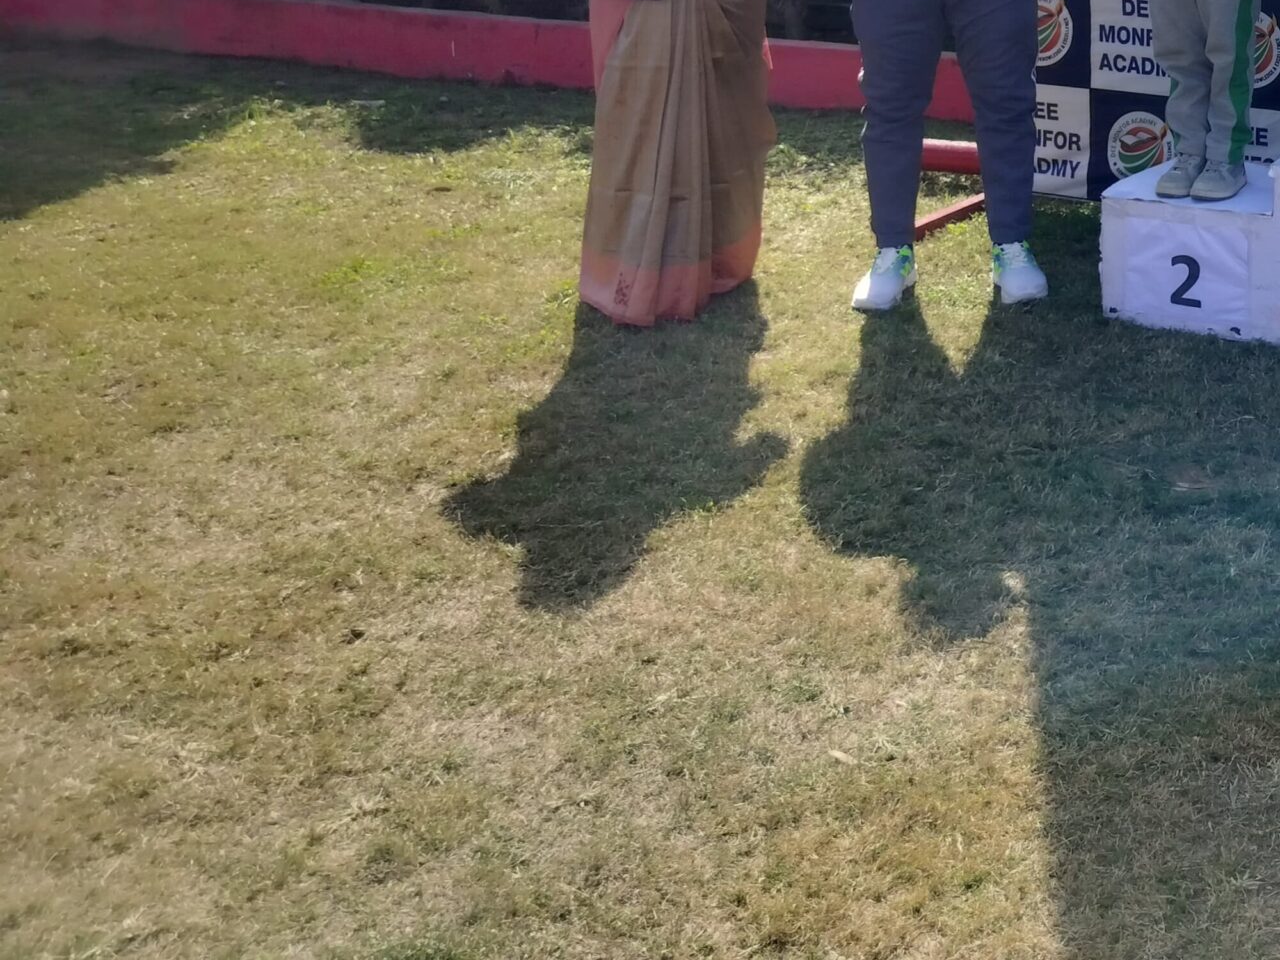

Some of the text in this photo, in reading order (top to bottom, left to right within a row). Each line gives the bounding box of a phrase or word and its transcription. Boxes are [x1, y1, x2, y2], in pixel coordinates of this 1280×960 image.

[1099, 24, 1153, 47] MONF
[1035, 102, 1059, 120] EE
[1035, 157, 1080, 179] DMY
[1170, 254, 1202, 309] 2
